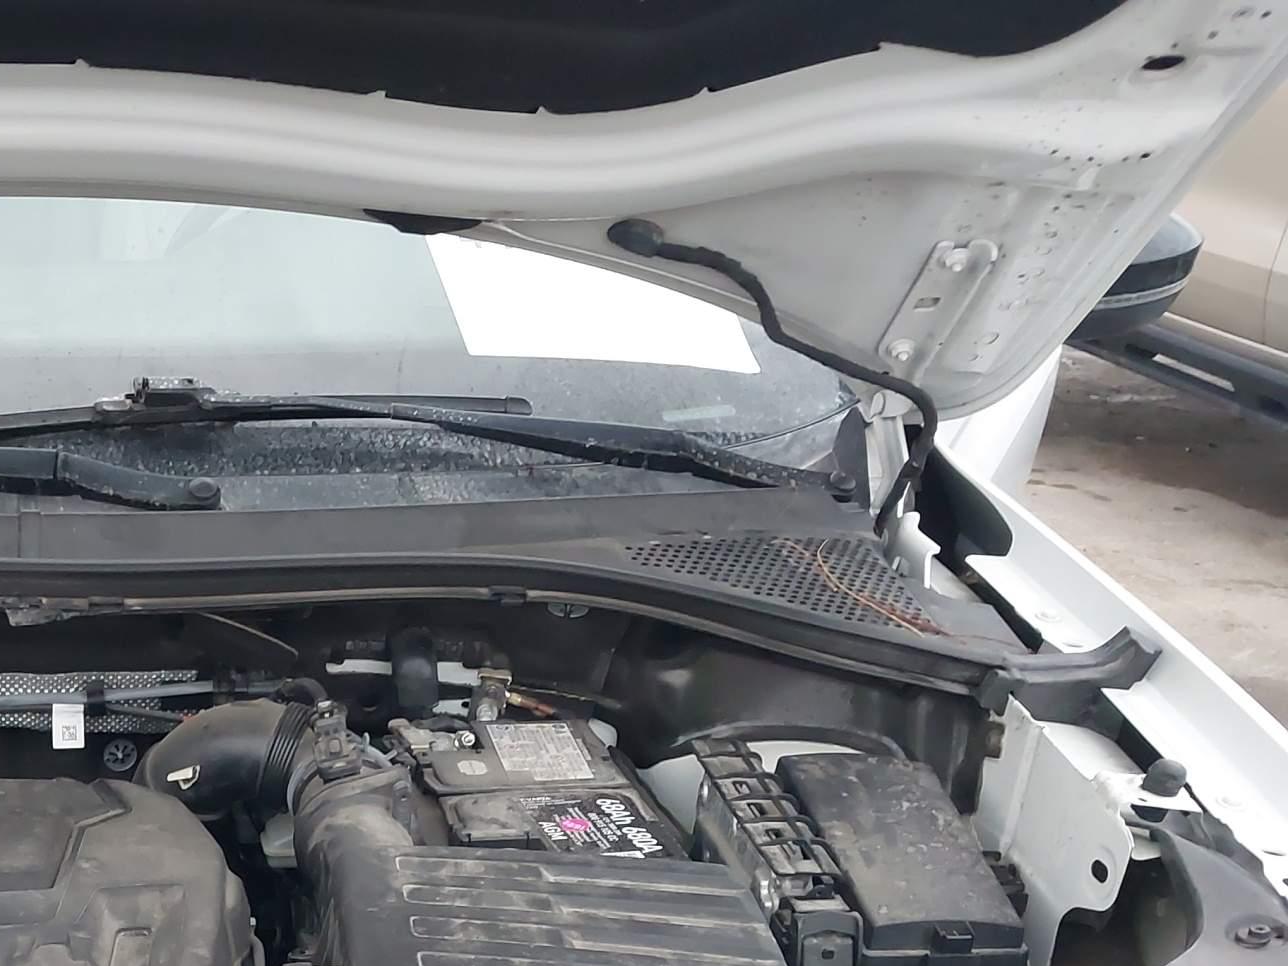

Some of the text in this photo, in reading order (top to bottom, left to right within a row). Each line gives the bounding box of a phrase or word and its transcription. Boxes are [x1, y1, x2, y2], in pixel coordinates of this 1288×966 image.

[538, 821, 568, 841] AGM
[596, 799, 635, 825] 68Ah
[622, 826, 663, 854] 680A
